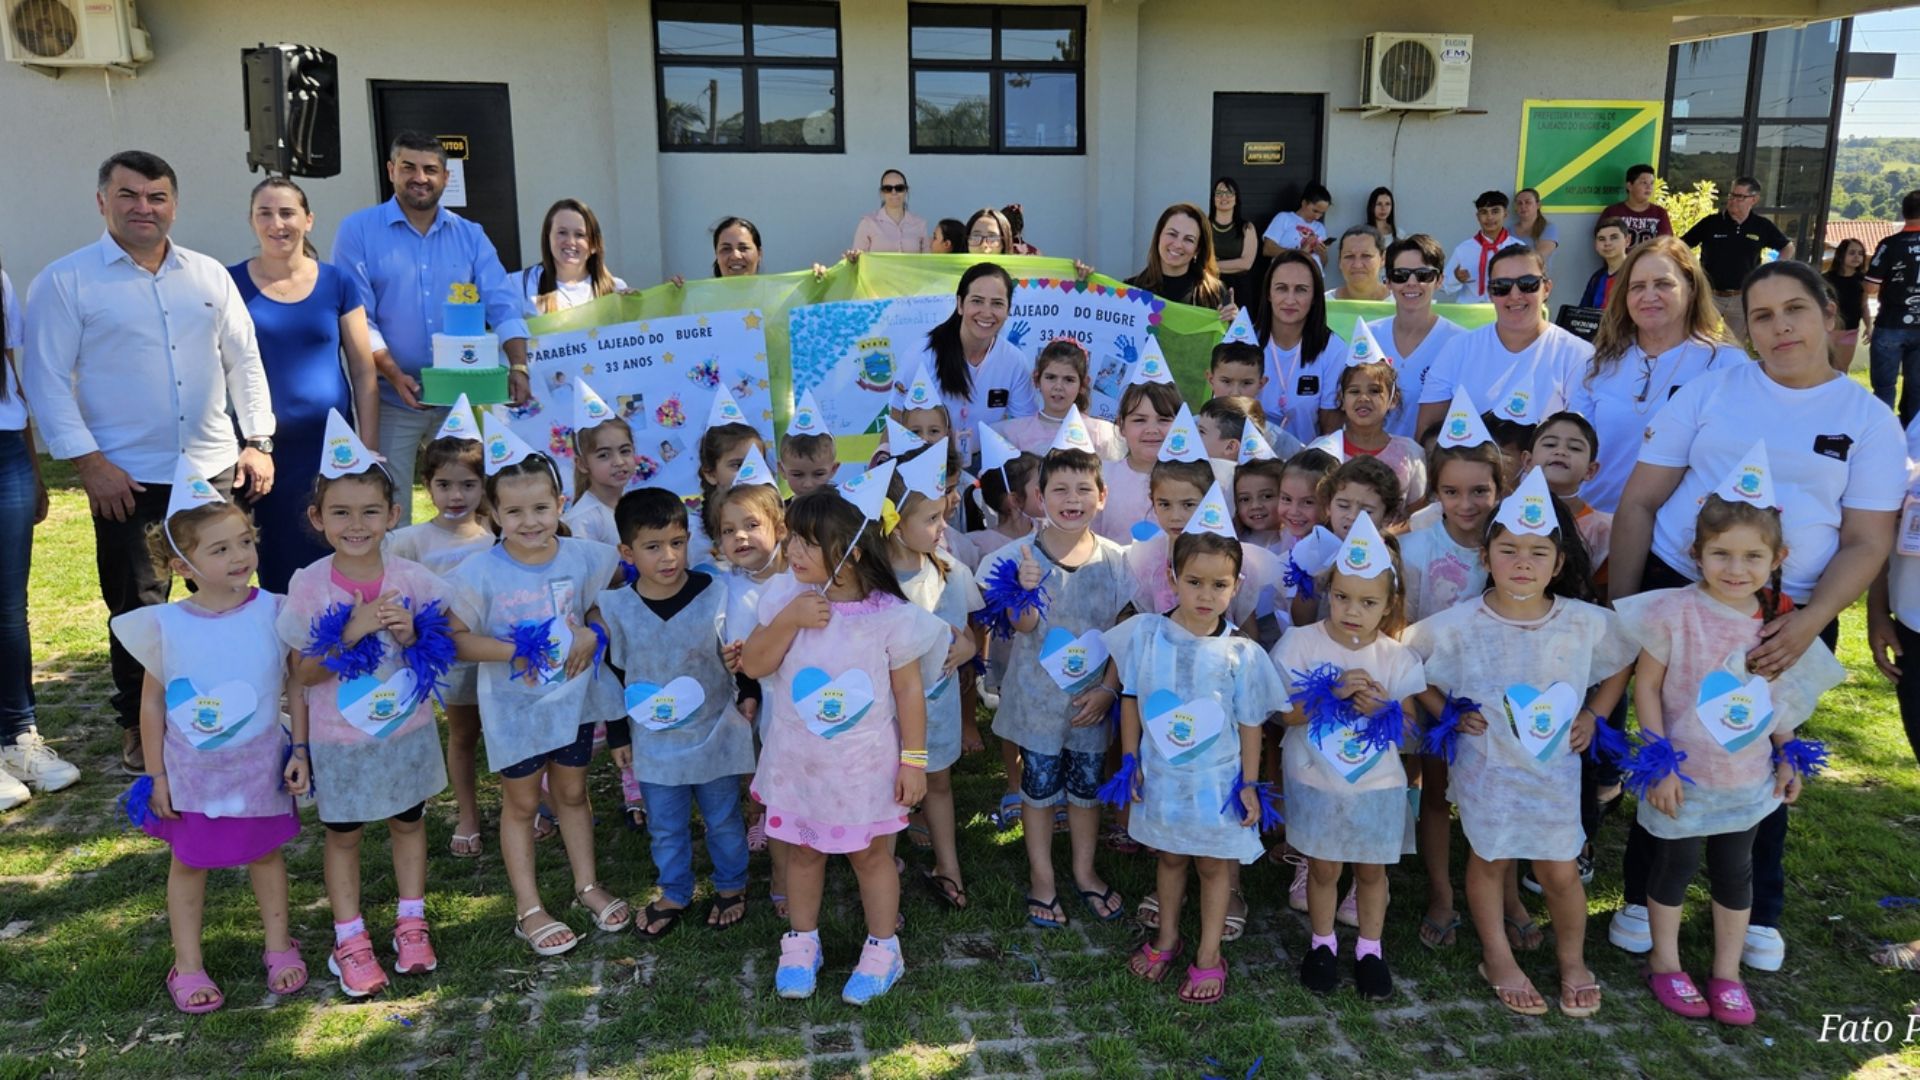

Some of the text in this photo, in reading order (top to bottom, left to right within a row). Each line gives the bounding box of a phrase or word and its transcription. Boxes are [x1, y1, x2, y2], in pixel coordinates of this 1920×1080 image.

[441, 141, 464, 151] UTOS
[447, 282, 480, 304] 33
[1008, 304, 1136, 327] LAJEADO DO BUGRE
[527, 326, 713, 363] PARABÉNS LAJEADO DO BUGRE
[1039, 329, 1093, 344] 33 ANOS
[605, 356, 654, 373] 33 ANOS
